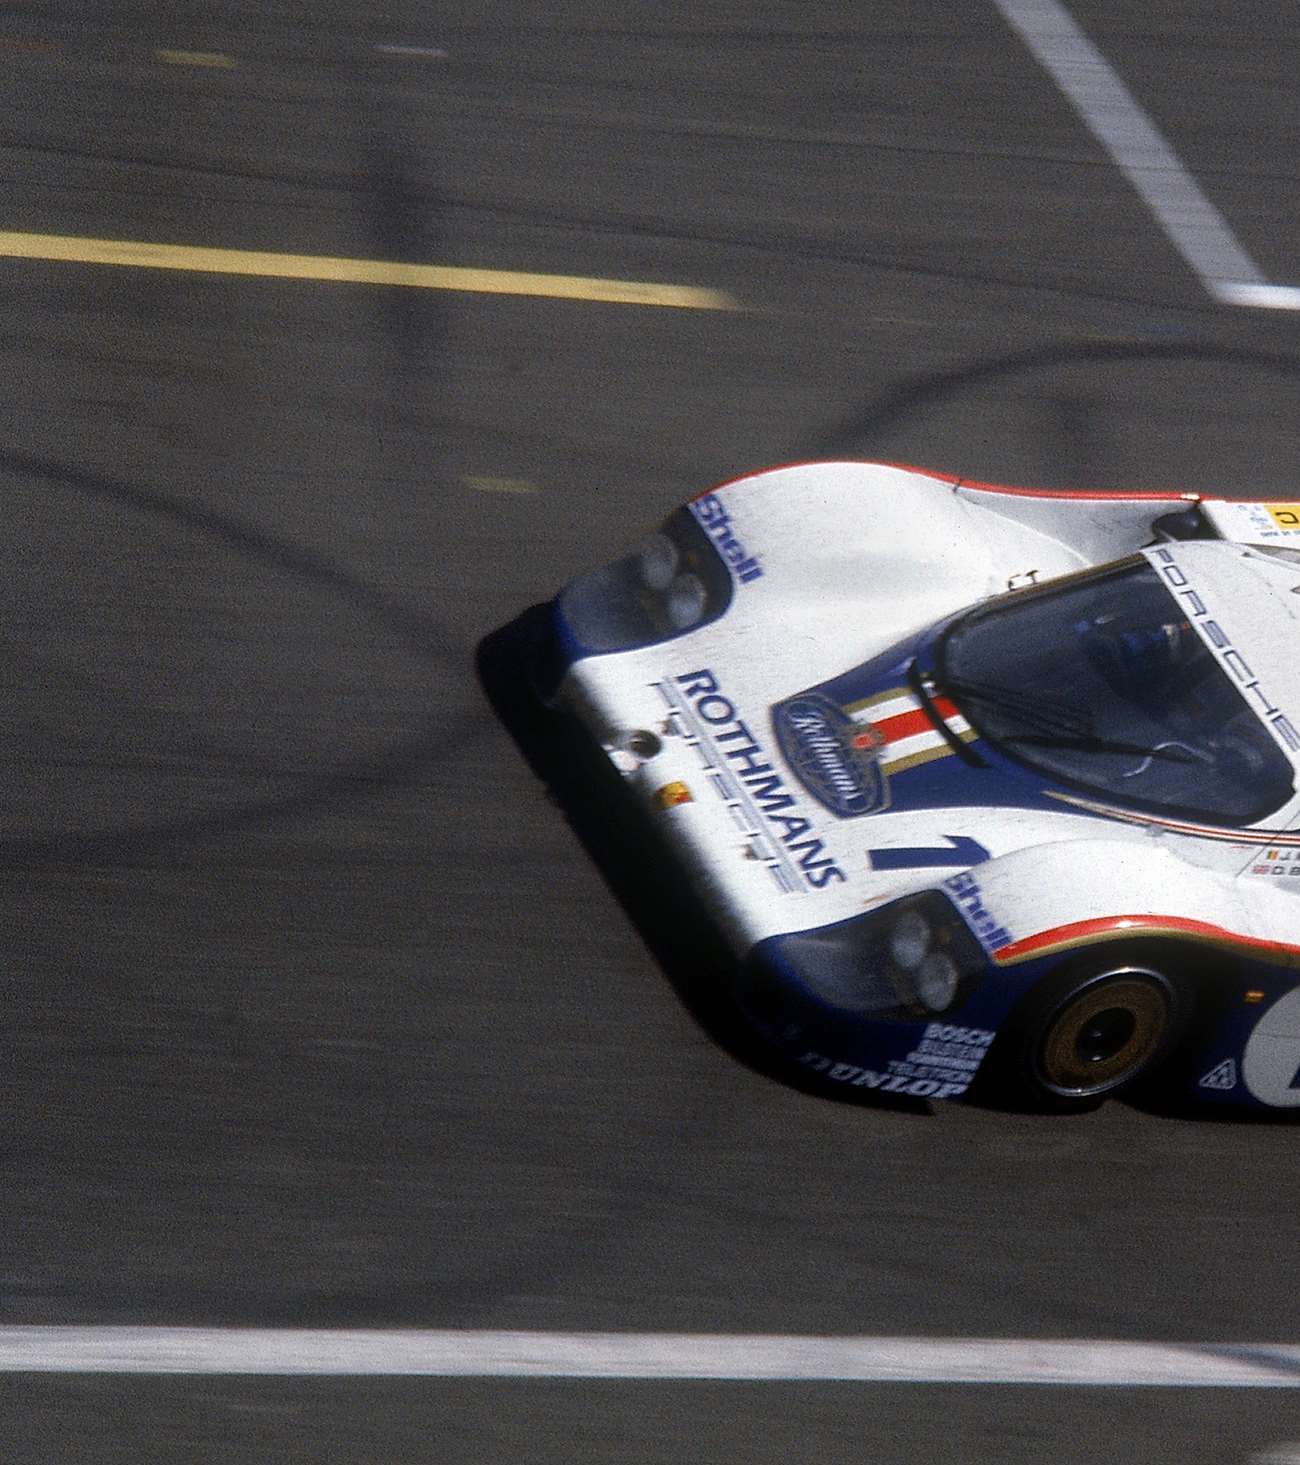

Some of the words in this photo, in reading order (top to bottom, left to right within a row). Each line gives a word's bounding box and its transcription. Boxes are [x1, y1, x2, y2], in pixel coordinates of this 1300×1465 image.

[694, 494, 763, 584] Shell
[676, 668, 847, 888] ROTHMANS
[867, 834, 991, 871] 1
[944, 872, 1010, 948] Shell
